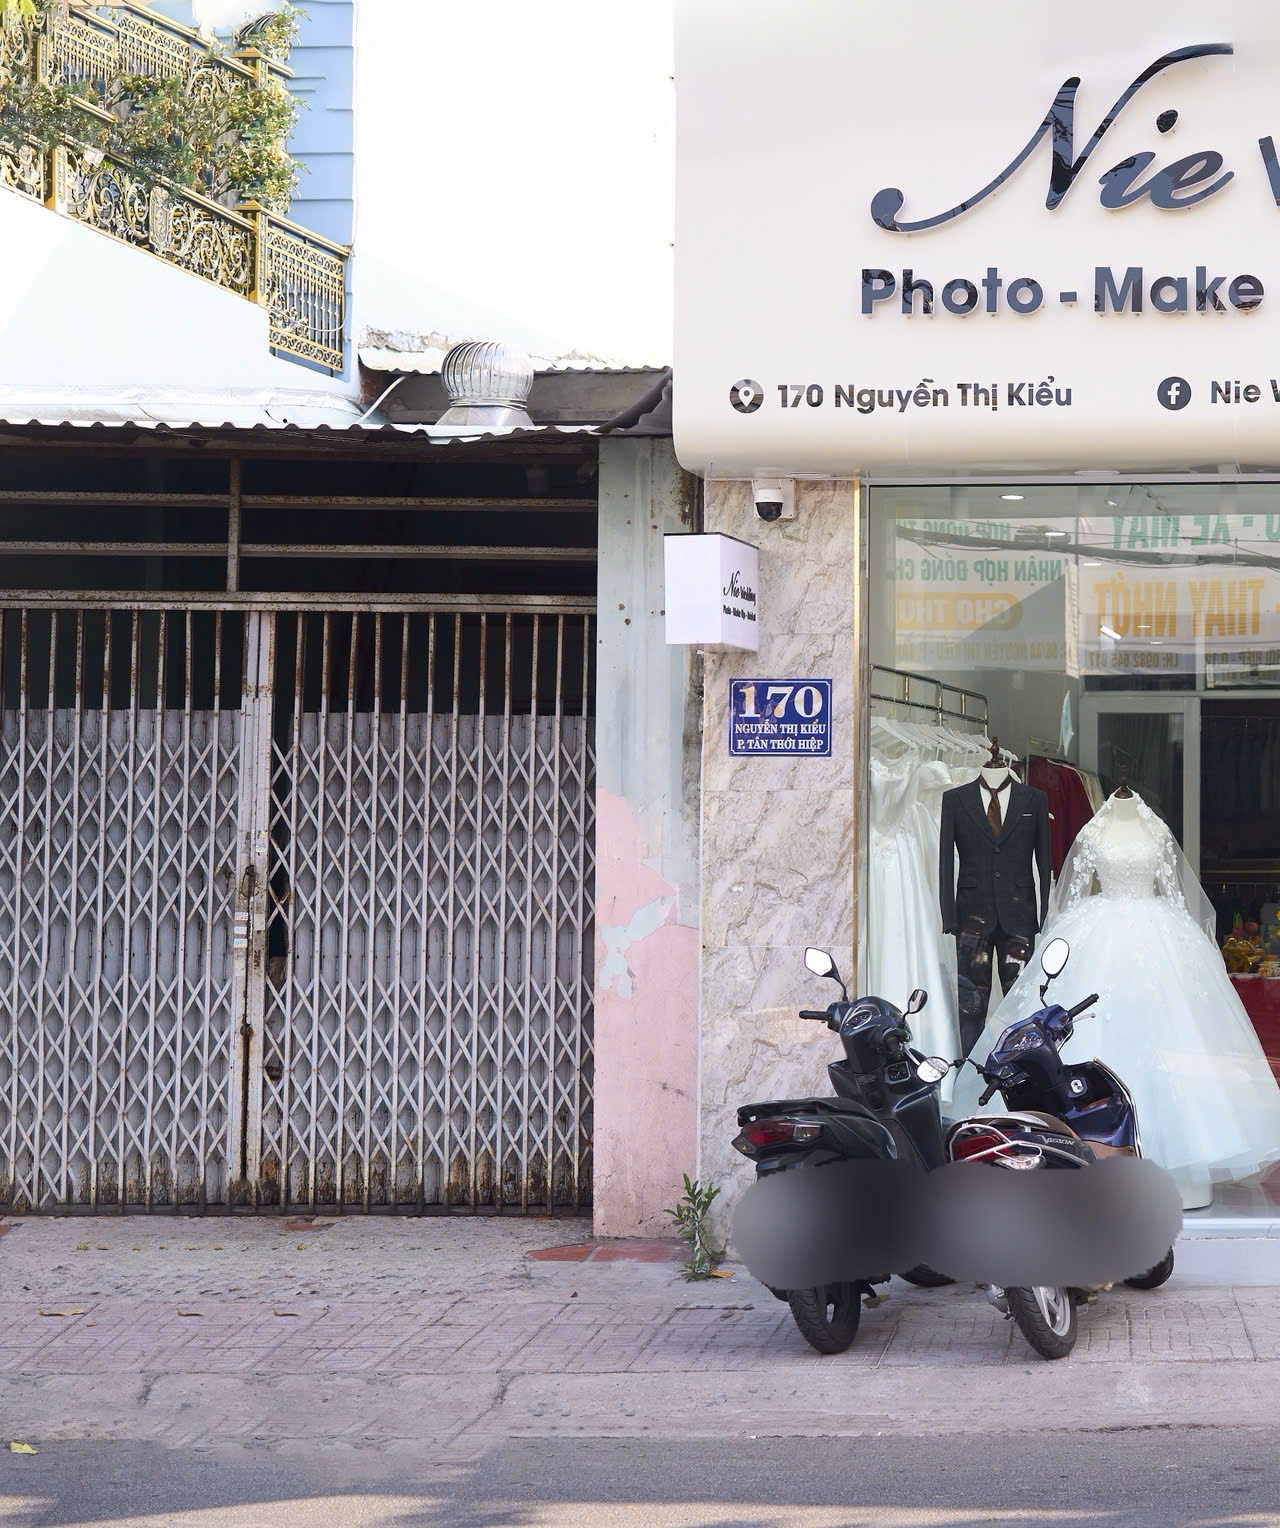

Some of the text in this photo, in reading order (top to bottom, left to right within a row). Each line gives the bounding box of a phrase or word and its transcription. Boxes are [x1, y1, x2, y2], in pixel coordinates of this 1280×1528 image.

[870, 43, 1236, 234] Nie
[861, 267, 1045, 315] Photo
[1094, 266, 1266, 314] Make
[777, 375, 1073, 416] 170 Nguyễn Thị Kiểu
[1211, 380, 1262, 405] Nie
[722, 570, 741, 598] Nie
[738, 685, 824, 719] 170
[735, 717, 827, 736] NGUYỄN THỊ KIỂU
[737, 736, 824, 752] P. TÂN THỚI HIỆP
